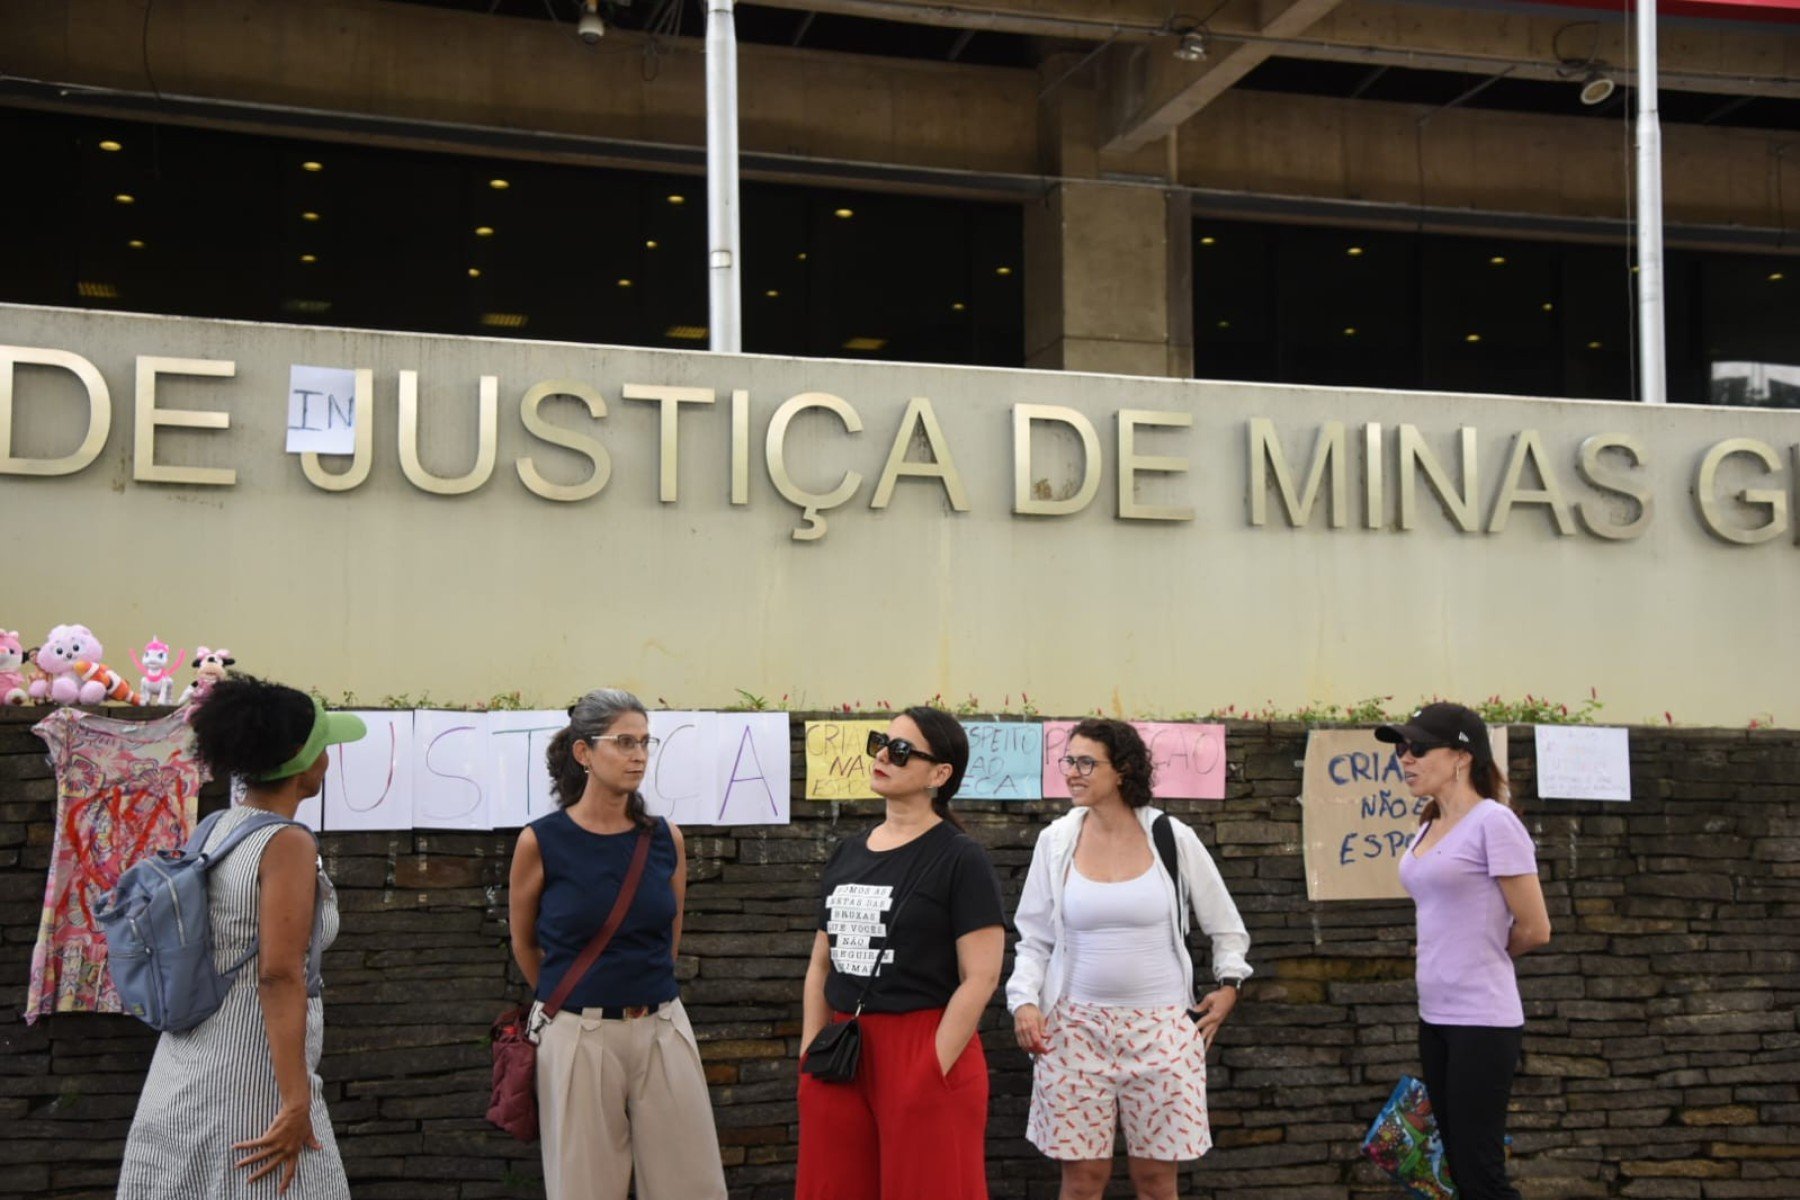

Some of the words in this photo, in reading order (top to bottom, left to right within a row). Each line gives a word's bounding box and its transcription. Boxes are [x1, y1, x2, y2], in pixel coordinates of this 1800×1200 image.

[288, 389, 355, 431] IN
[0, 344, 236, 485] DE
[301, 368, 970, 540] JUSTIÇA
[1012, 402, 1193, 521] DE
[1249, 417, 1654, 540] MINAS
[806, 723, 869, 757] CRIA
[964, 725, 1039, 755] SPEITO
[1327, 750, 1404, 786] CRIA
[1361, 789, 1407, 820] NÃO
